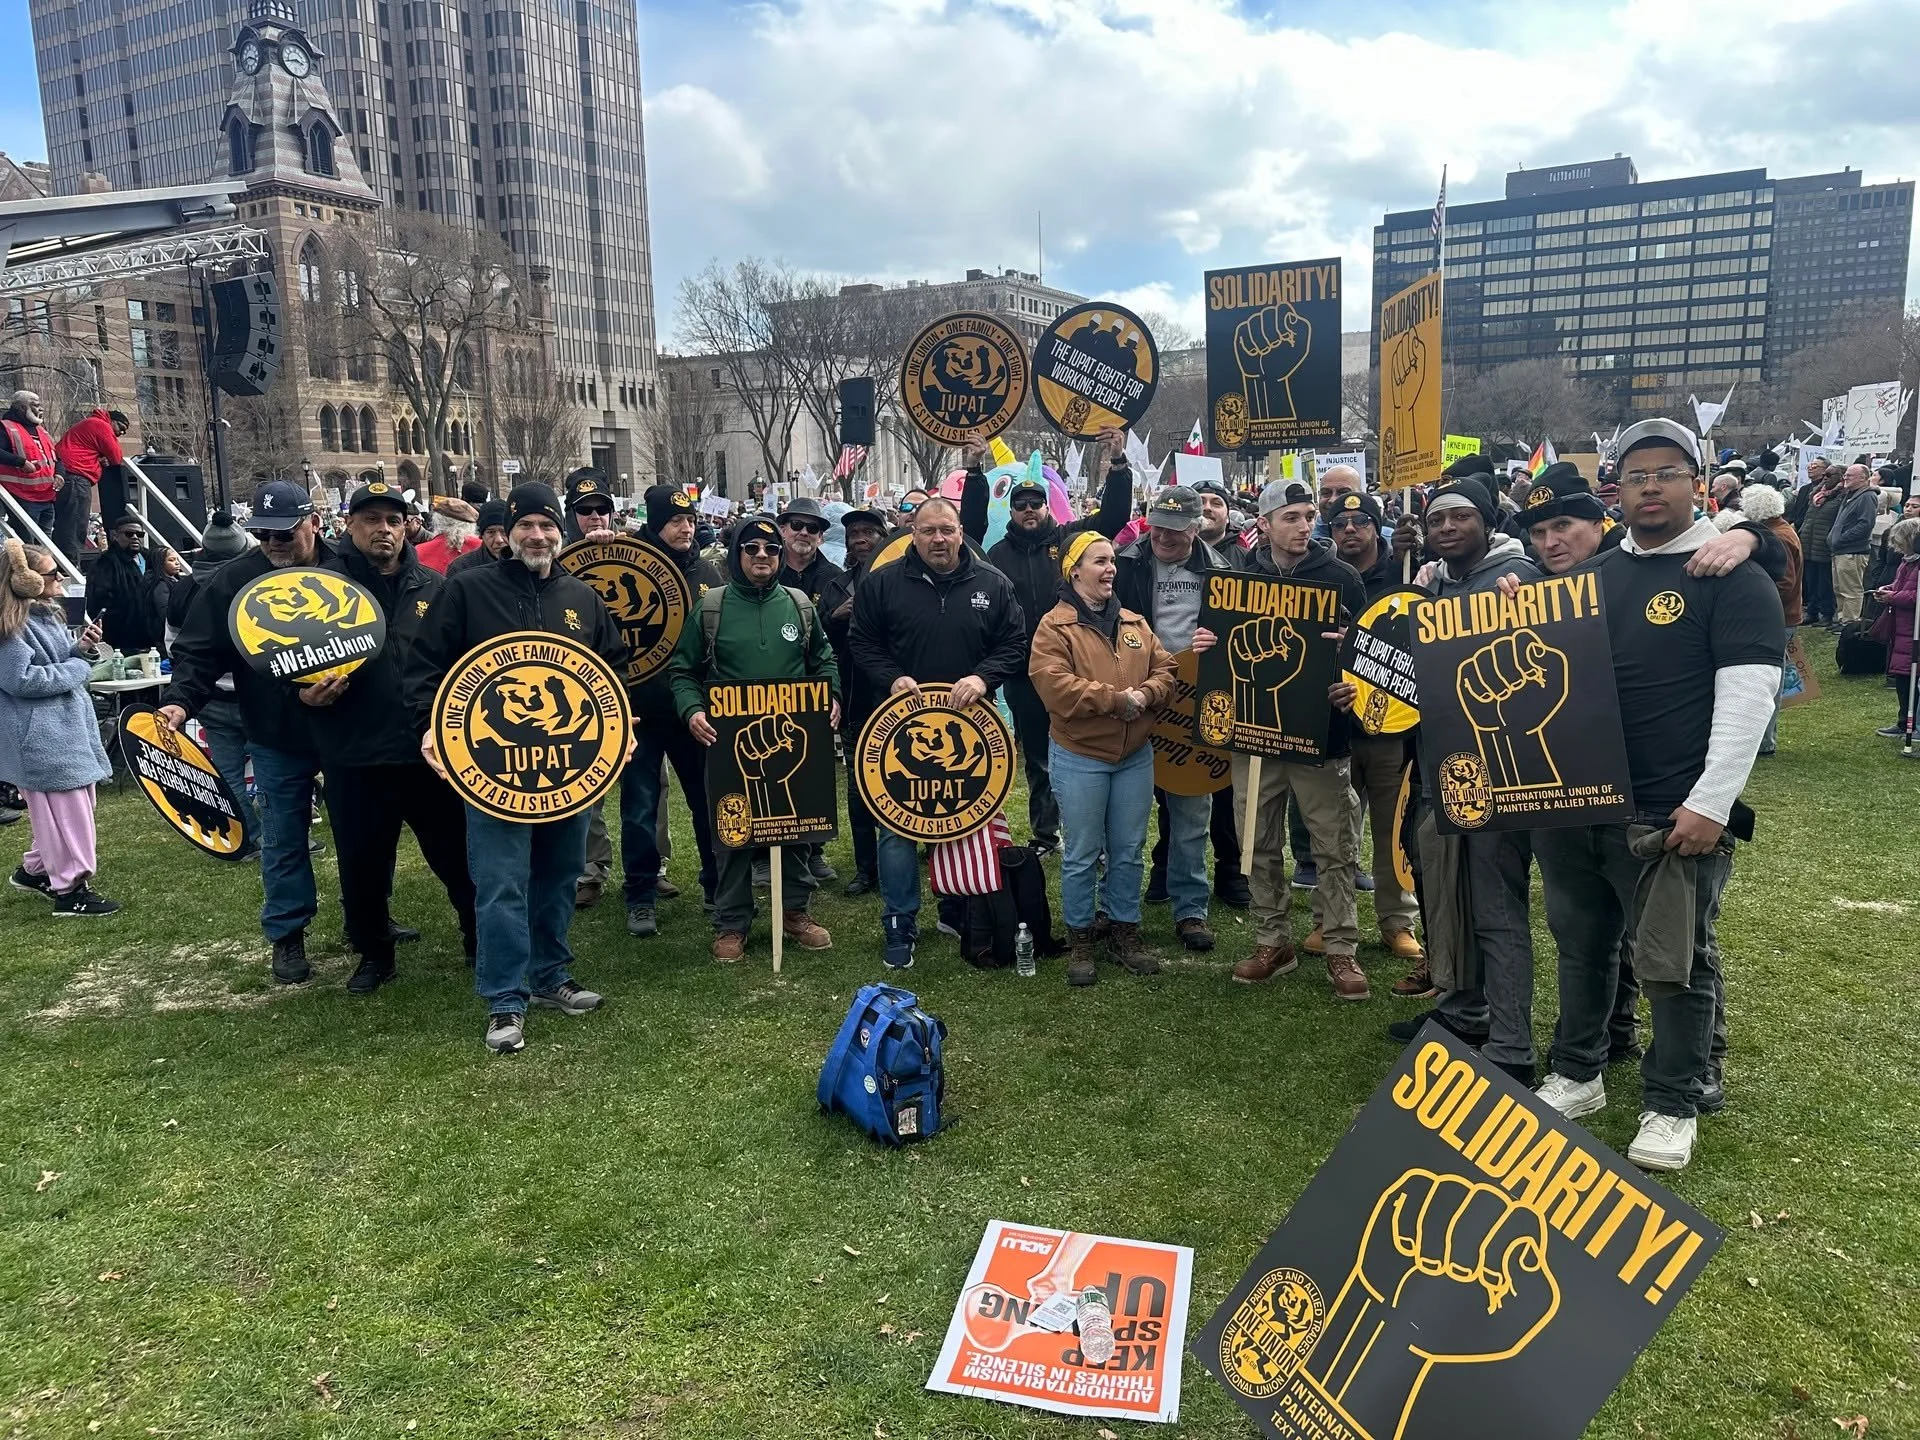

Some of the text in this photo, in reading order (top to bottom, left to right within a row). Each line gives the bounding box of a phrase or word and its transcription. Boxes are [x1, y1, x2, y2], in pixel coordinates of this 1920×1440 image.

[1210, 264, 1337, 310] SOLIDARITY!
[1383, 280, 1438, 343] SOLIDARITY!
[908, 320, 1022, 382] ONE UNION ONE FAMILY ONE FIGHT
[1051, 339, 1144, 399] THE IUPAT FIGHTS FOR
[1051, 361, 1127, 412] WORKING PEOPLE
[941, 391, 986, 412] IUPAT
[985, 408, 1010, 433] 1887
[1251, 421, 1298, 431] INTERNATIONAL
[1299, 420, 1320, 428] UNION
[1251, 427, 1336, 439] PAINTERS & ALLIED TRADES
[1326, 456, 1358, 465] INJUSTICE
[576, 546, 681, 607] ONE FAMILY ONE FIGHT
[1209, 576, 1337, 624] SOLIDARITY!
[1416, 572, 1599, 644] SOLIDARITY!
[492, 648, 521, 667] ONE
[523, 644, 570, 665] FAMILY
[645, 636, 674, 667] 1887
[1354, 629, 1371, 653] THE
[1368, 639, 1394, 664] IUPAT
[452, 663, 488, 703] UNION
[577, 662, 602, 689] ONE
[1353, 653, 1392, 688] WORKING
[597, 684, 620, 719] FIGHT
[709, 681, 830, 718] SOLIDARITY!
[905, 695, 927, 713] ONE
[445, 701, 464, 729] ONE
[872, 710, 900, 743] UNION
[972, 709, 994, 730] ONE
[988, 729, 1005, 759] FIGHT
[1235, 726, 1282, 741] INTERNATIONAL
[1284, 735, 1304, 745] UNION
[1235, 734, 1264, 745] PAINTERS
[1272, 741, 1294, 750] ALLIED
[1295, 744, 1320, 755] TRADES
[138, 740, 219, 794] WORKING PEOPLE
[503, 744, 573, 773] IUPAT
[866, 741, 880, 764] ONE
[1195, 750, 1230, 779] One
[135, 755, 159, 782] FOR
[158, 766, 192, 797] FIGHTS
[459, 756, 612, 811] ESTABLISHED 1887
[910, 779, 965, 800] IUPAT
[1443, 787, 1491, 803] ONE UNION
[1496, 784, 1613, 804] INTERNATIONAL UNION OF
[214, 794, 236, 817] THE
[874, 790, 997, 833] ESTABLISHED 1887
[1497, 795, 1624, 814] PAINTERS & ALLIED TRADES
[753, 816, 827, 829] INTERNATIONAL UNION OF
[753, 823, 833, 837] PAINTERS & ALLIED TRADES
[1392, 1041, 1704, 1305] SOLIDARITY!
[1001, 1237, 1053, 1256] ACLU
[1250, 1271, 1322, 1355] PAINTERS AND ALLIED TRADES
[1237, 1306, 1298, 1376] ONE UNION
[966, 1350, 1154, 1391] THRIVES IN SILENCE.
[1061, 1344, 1157, 1372] KEP
[1222, 1323, 1286, 1395] INTERNATIONAL UNION
[1242, 1353, 1257, 1370] AFL-CIO
[962, 1363, 1155, 1404] AUTHORITARIANISM
[1270, 1410, 1295, 1438] TEXT
